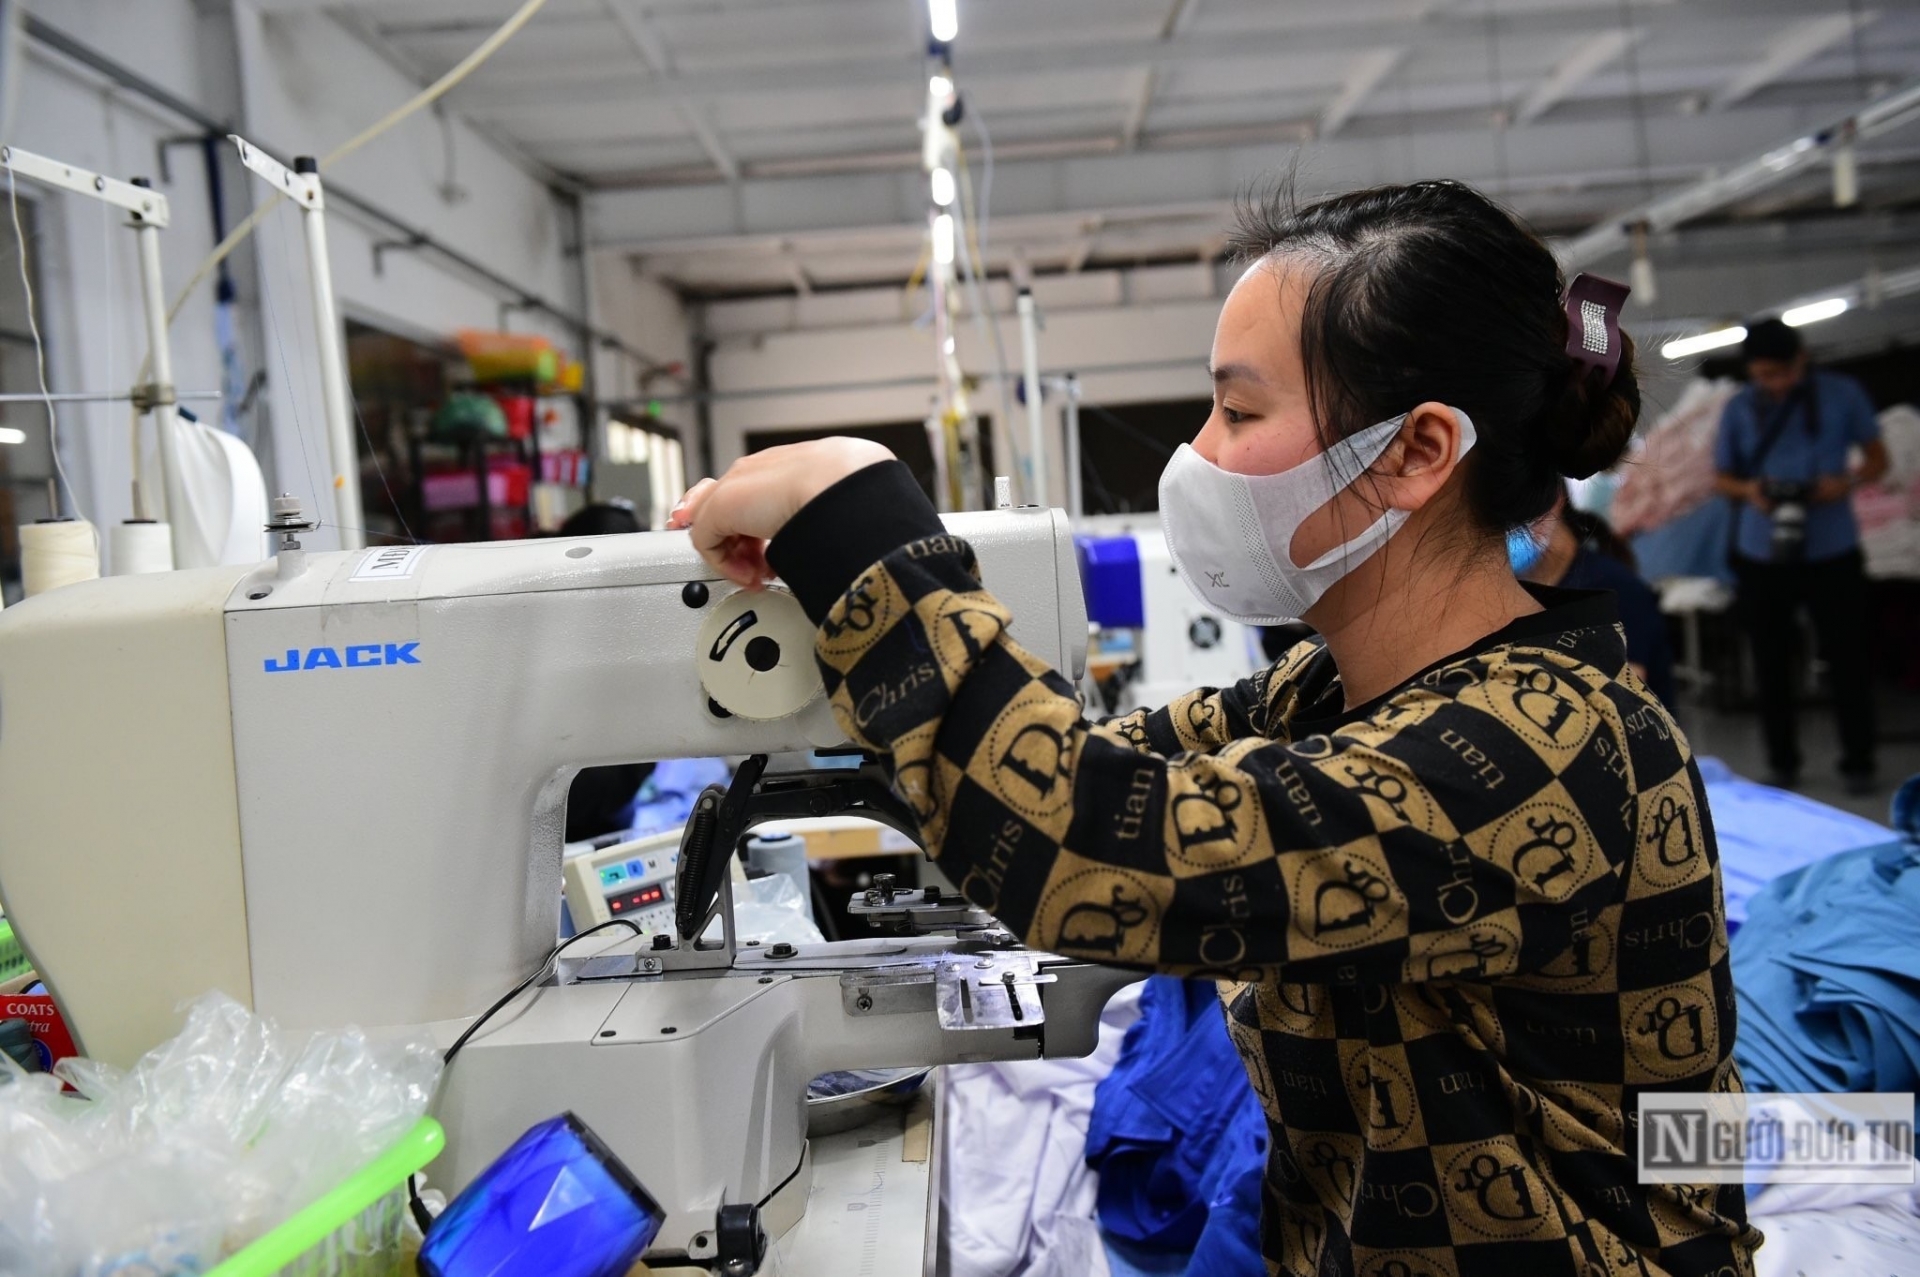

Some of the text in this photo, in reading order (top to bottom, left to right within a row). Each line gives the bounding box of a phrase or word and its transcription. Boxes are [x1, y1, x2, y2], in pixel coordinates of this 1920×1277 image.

[264, 642, 421, 672] JACK
[855, 662, 935, 728] Chris
[1439, 728, 1506, 791] tian
[1114, 768, 1156, 840] tian
[1623, 911, 1715, 949] Chris
[6, 1002, 55, 1016] COATS
[28, 1020, 50, 1033] tra
